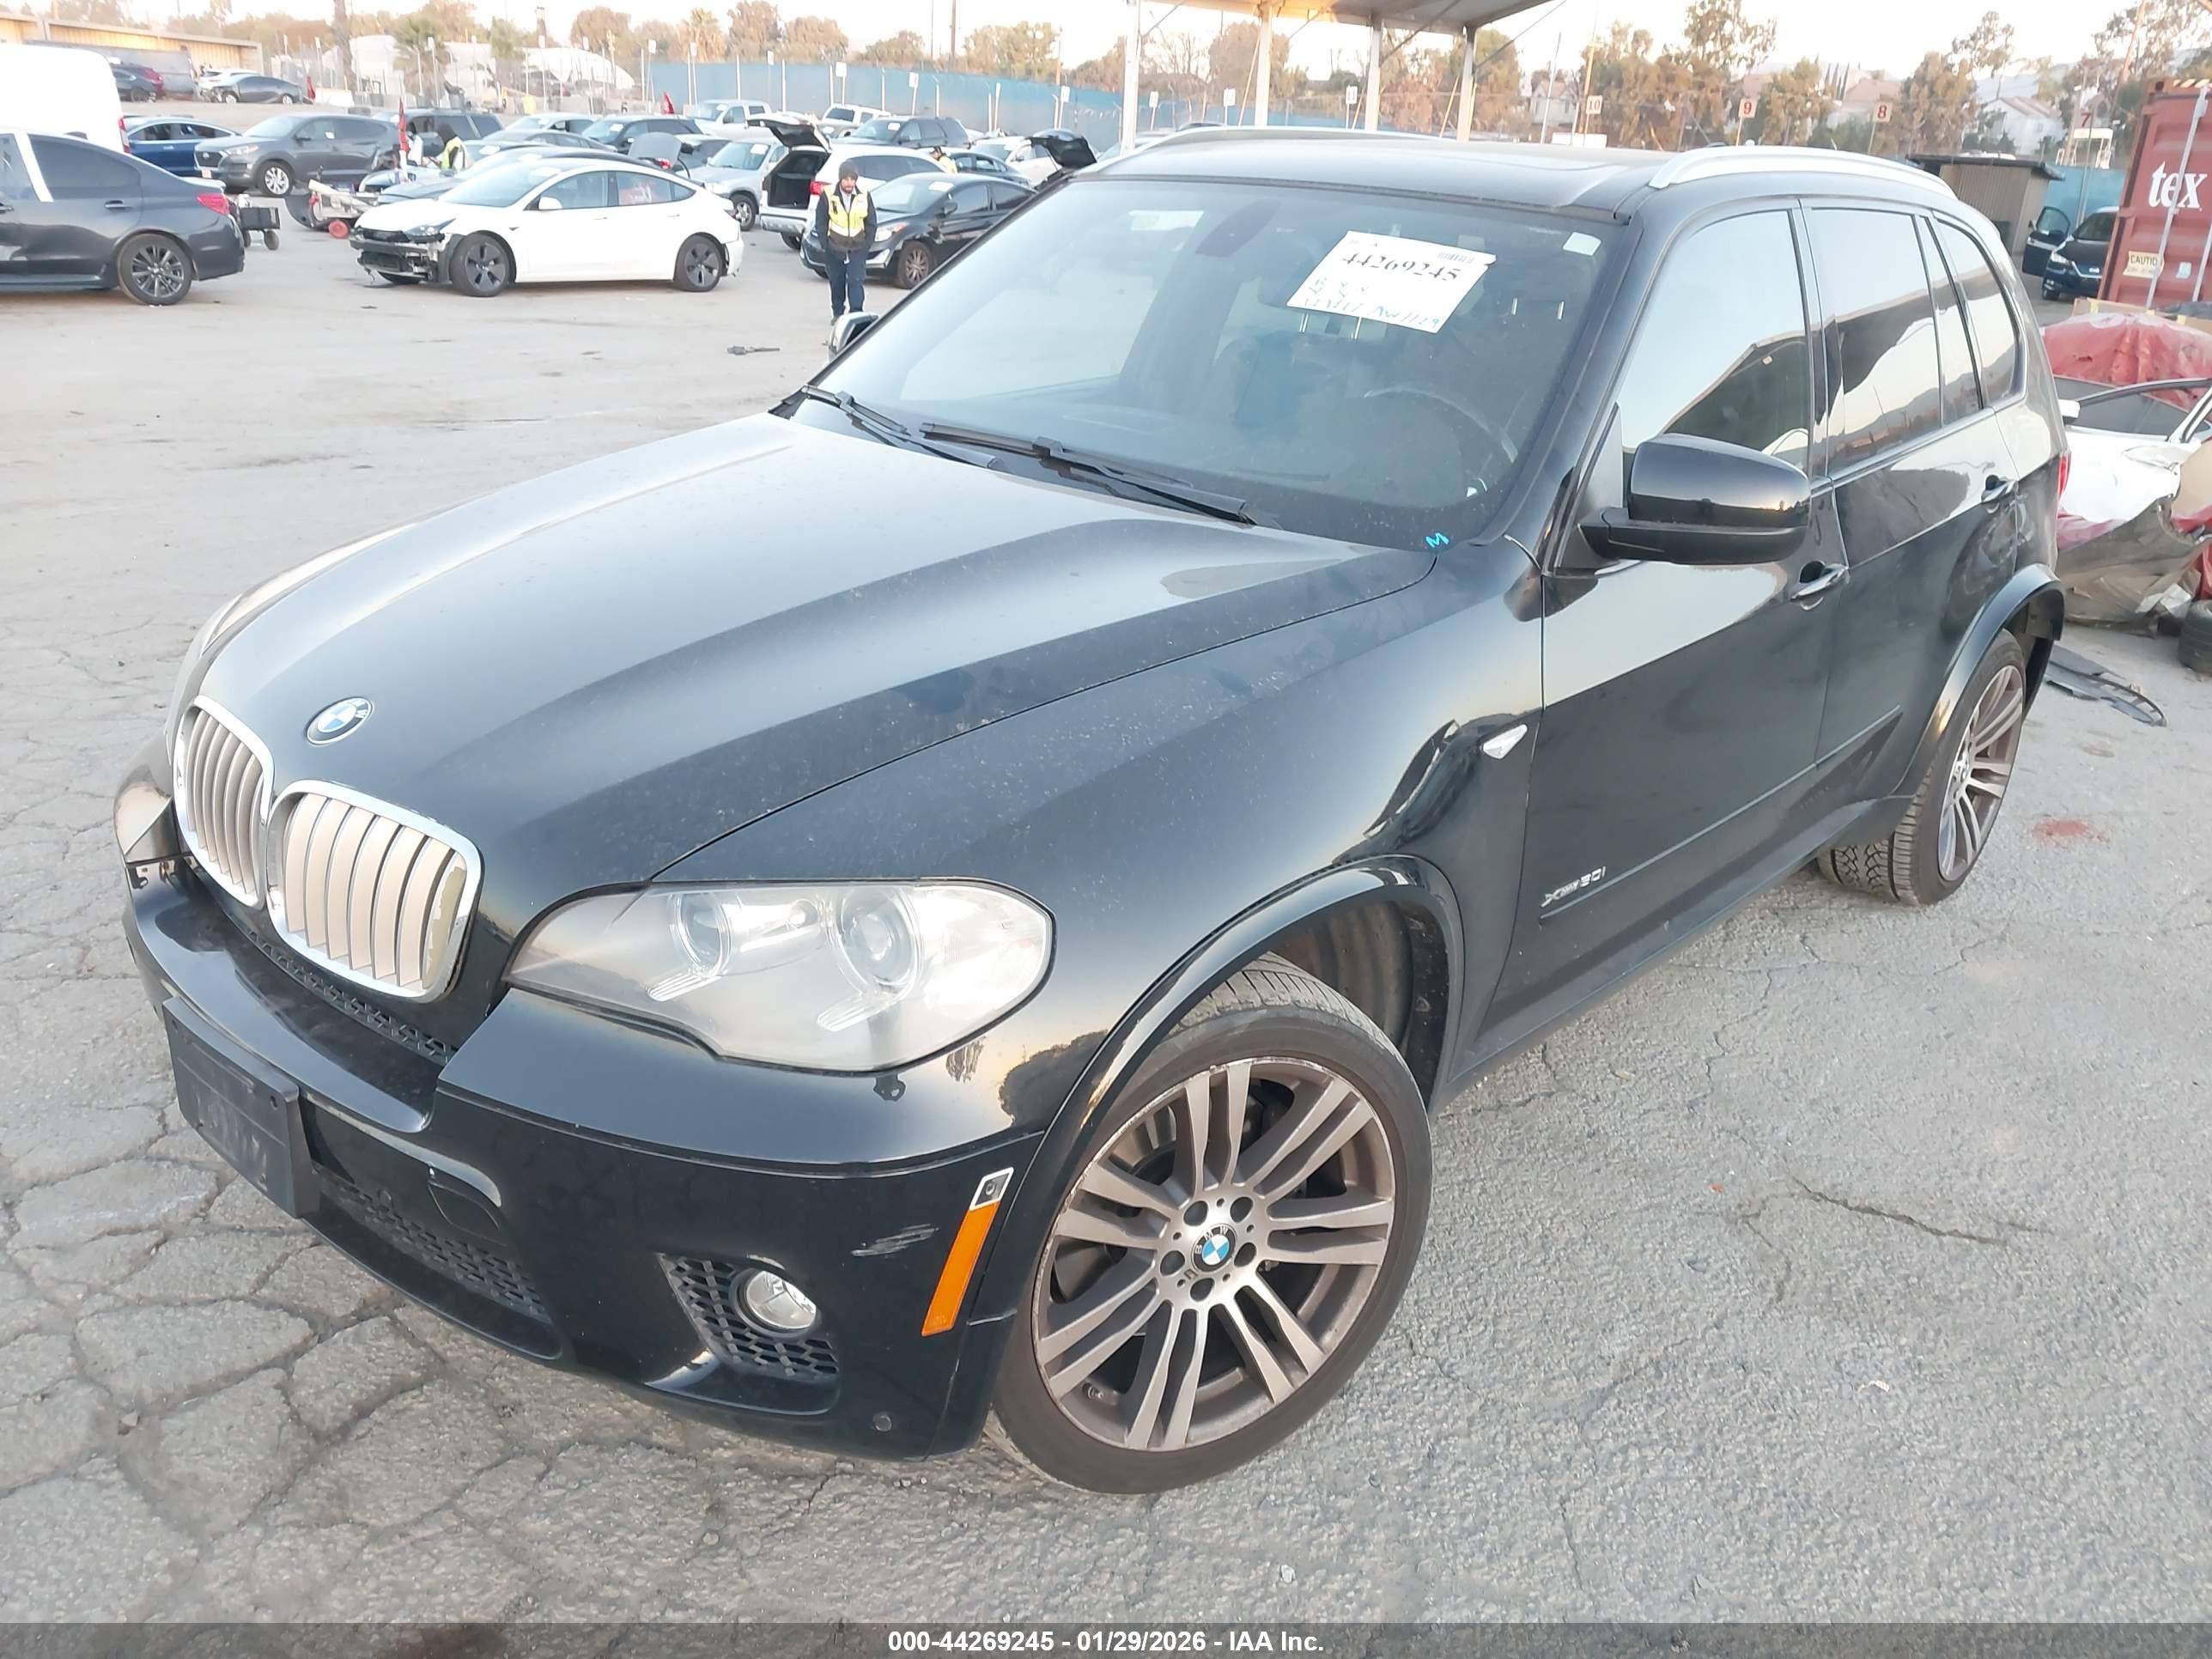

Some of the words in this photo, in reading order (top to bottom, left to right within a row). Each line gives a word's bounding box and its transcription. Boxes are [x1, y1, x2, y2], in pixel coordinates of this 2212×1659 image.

[1589, 99, 1601, 111] 10
[1743, 101, 1753, 115] 9
[1876, 104, 1887, 119] 8
[2081, 112, 2094, 128] 7
[1342, 252, 1462, 282] 44269245
[2130, 254, 2163, 267] CAUTIO
[1194, 1225, 1229, 1255] BMW
